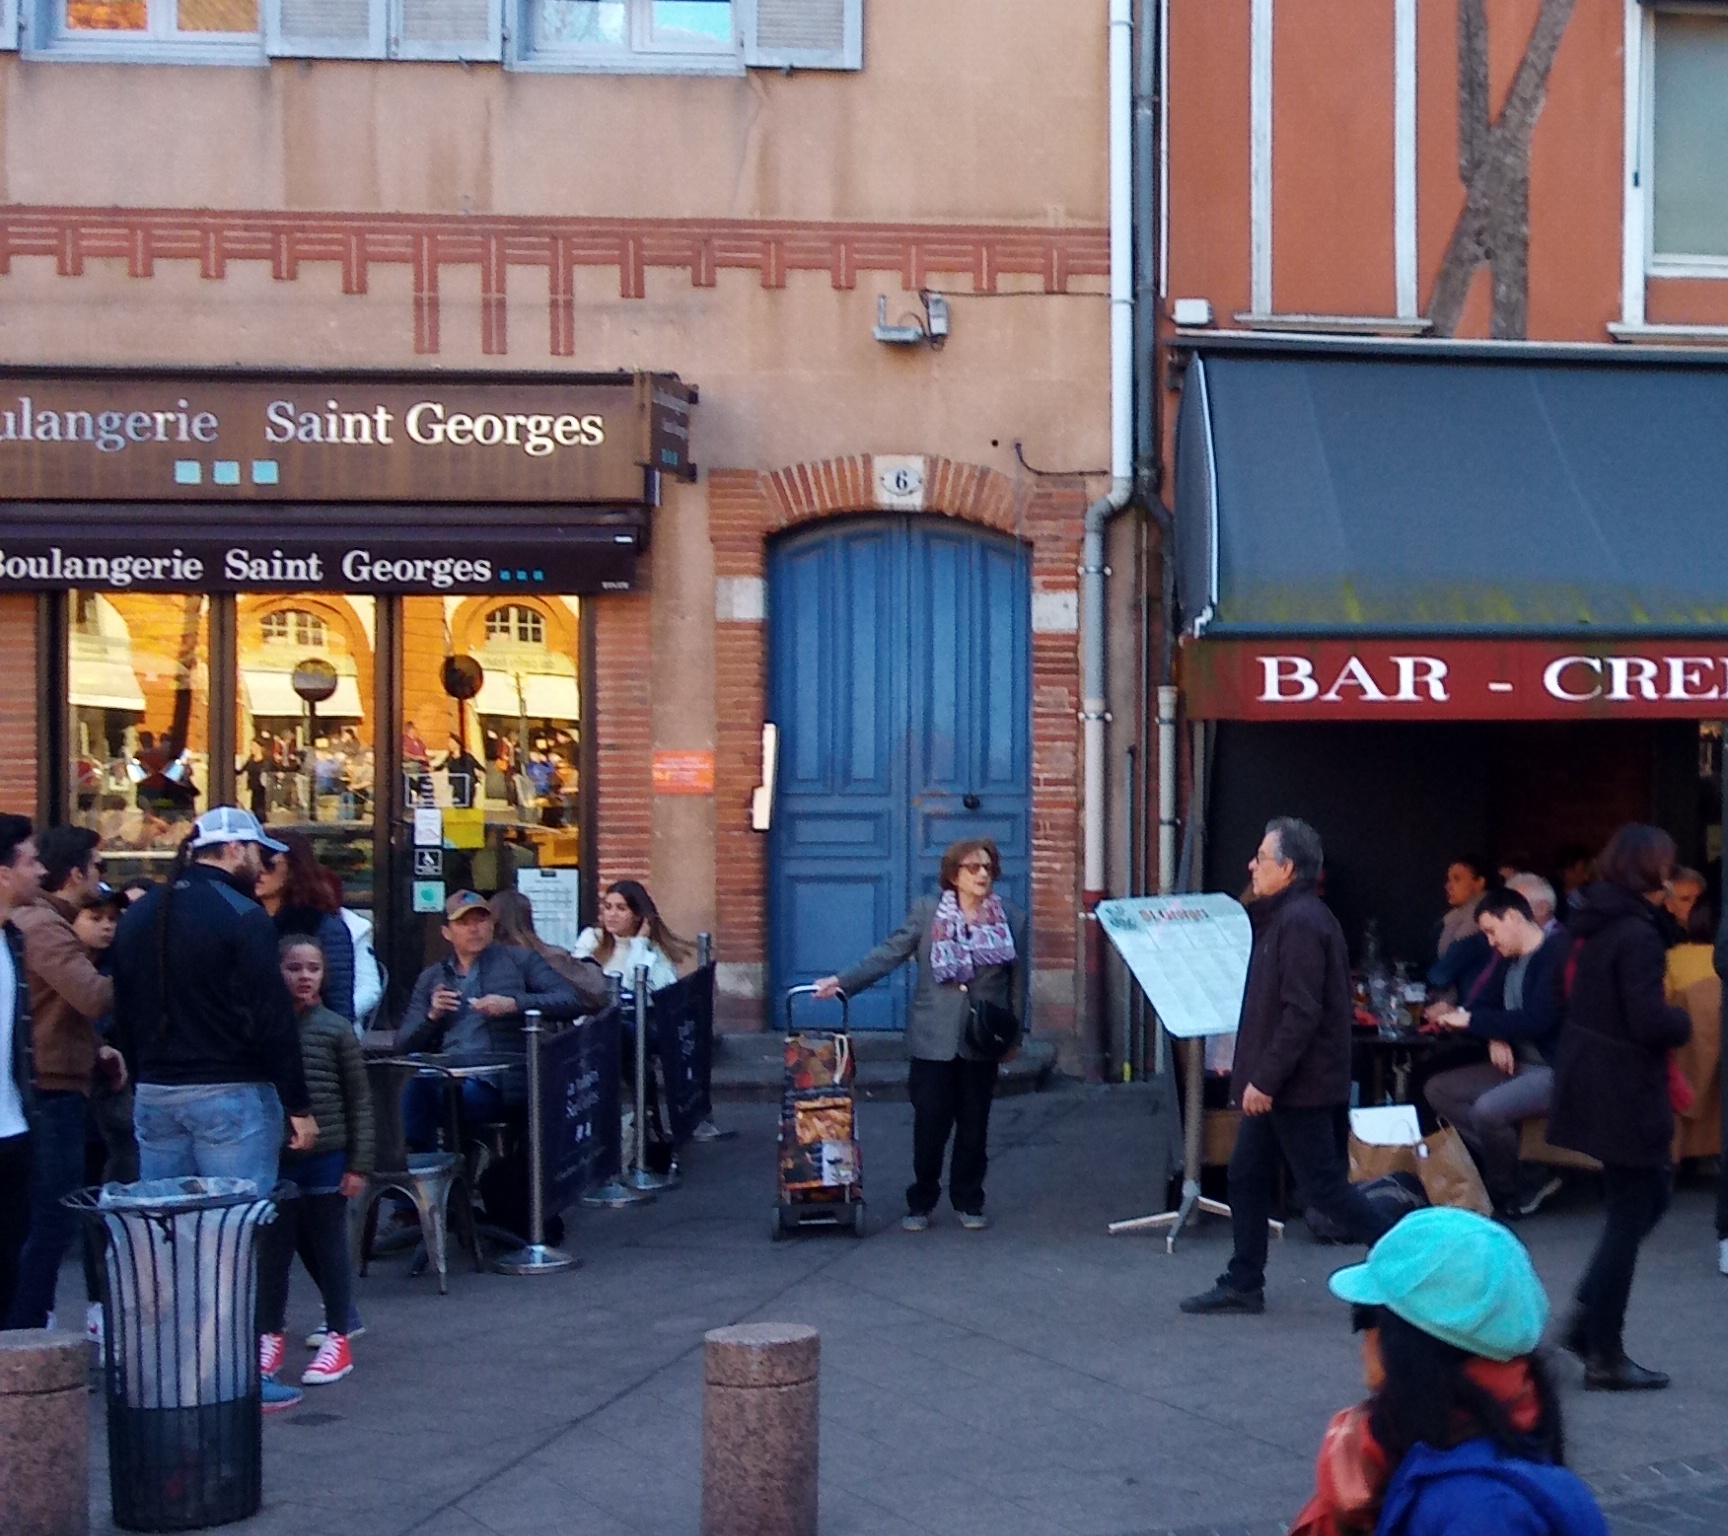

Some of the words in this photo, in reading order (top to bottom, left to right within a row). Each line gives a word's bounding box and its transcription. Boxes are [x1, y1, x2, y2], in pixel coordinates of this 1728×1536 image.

[265, 399, 394, 445] Saint
[405, 401, 605, 457] Georges
[896, 469, 908, 491] 6
[224, 548, 324, 582] Saint
[341, 550, 492, 588] Georges
[1256, 655, 1449, 703] BAR
